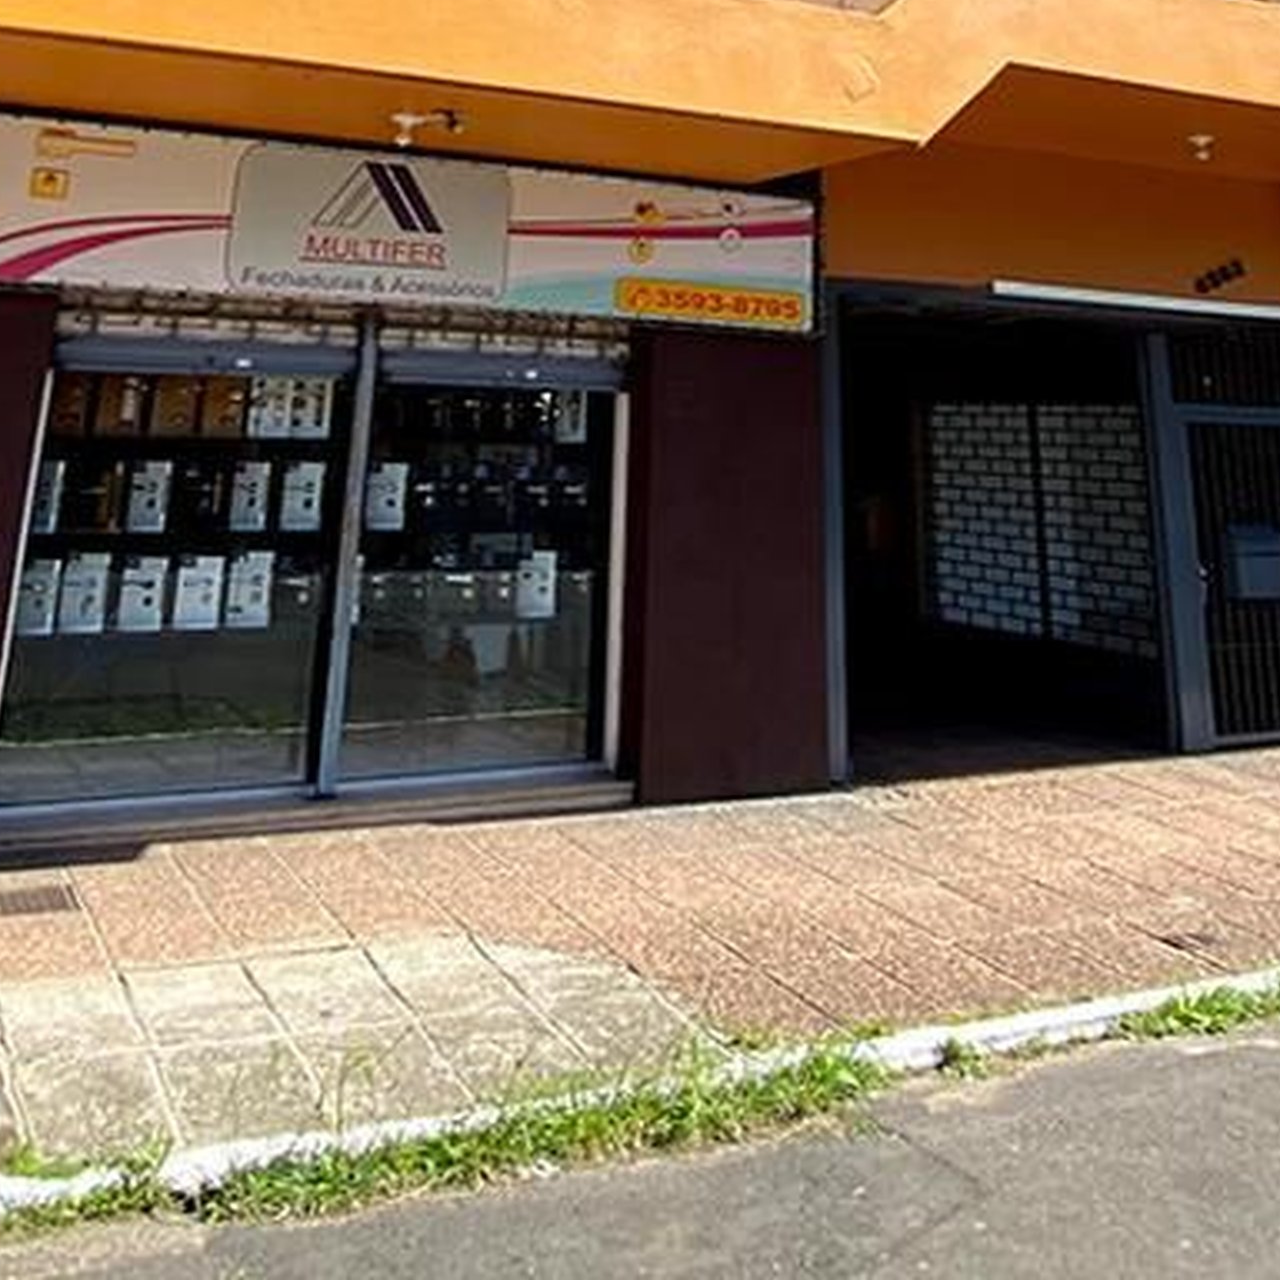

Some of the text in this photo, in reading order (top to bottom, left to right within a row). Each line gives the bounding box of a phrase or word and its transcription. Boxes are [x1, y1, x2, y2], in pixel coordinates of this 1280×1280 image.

[304, 233, 448, 266] MULTIFER
[240, 266, 365, 292] Fechaduras
[371, 274, 385, 294] &
